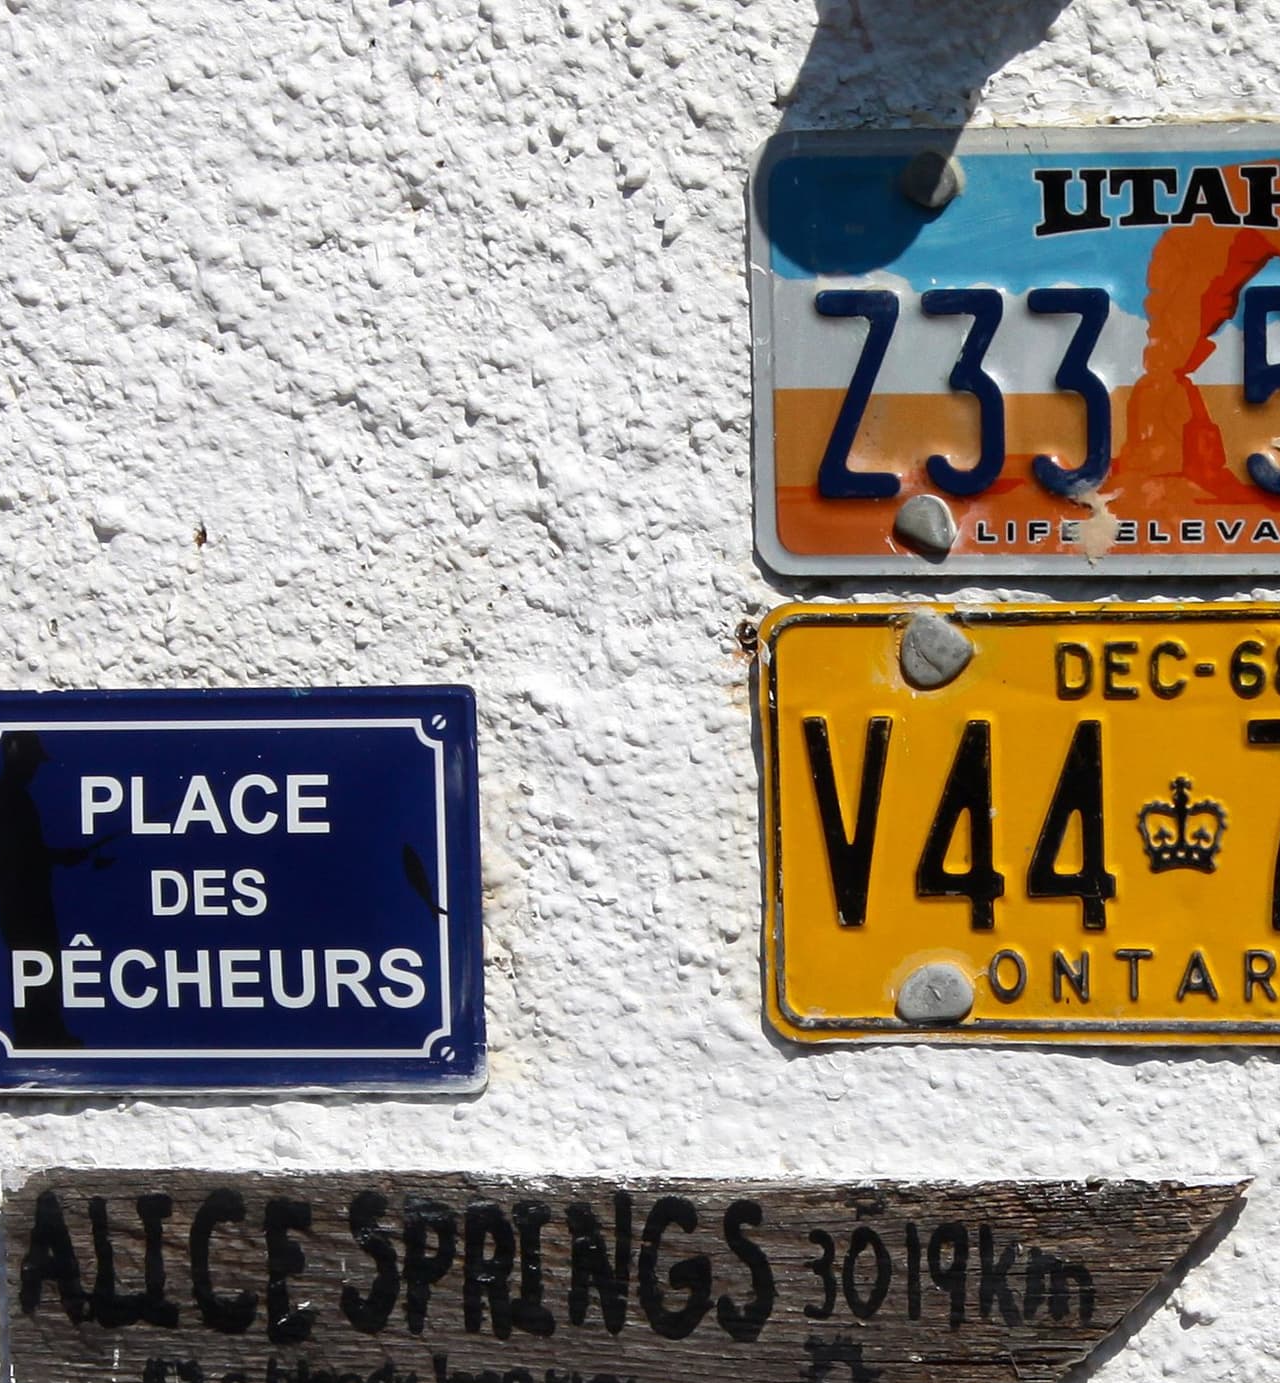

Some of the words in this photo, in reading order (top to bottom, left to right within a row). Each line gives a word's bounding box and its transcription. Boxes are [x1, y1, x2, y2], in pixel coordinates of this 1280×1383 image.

[814, 287, 1112, 498] Z33
[80, 774, 332, 835] PLACE
[801, 715, 1117, 931] V44
[150, 868, 268, 916] DES
[11, 934, 426, 1008] PÊCHEURS
[19, 1187, 314, 1344] ALICE
[340, 1188, 778, 1342] SPRINGS
